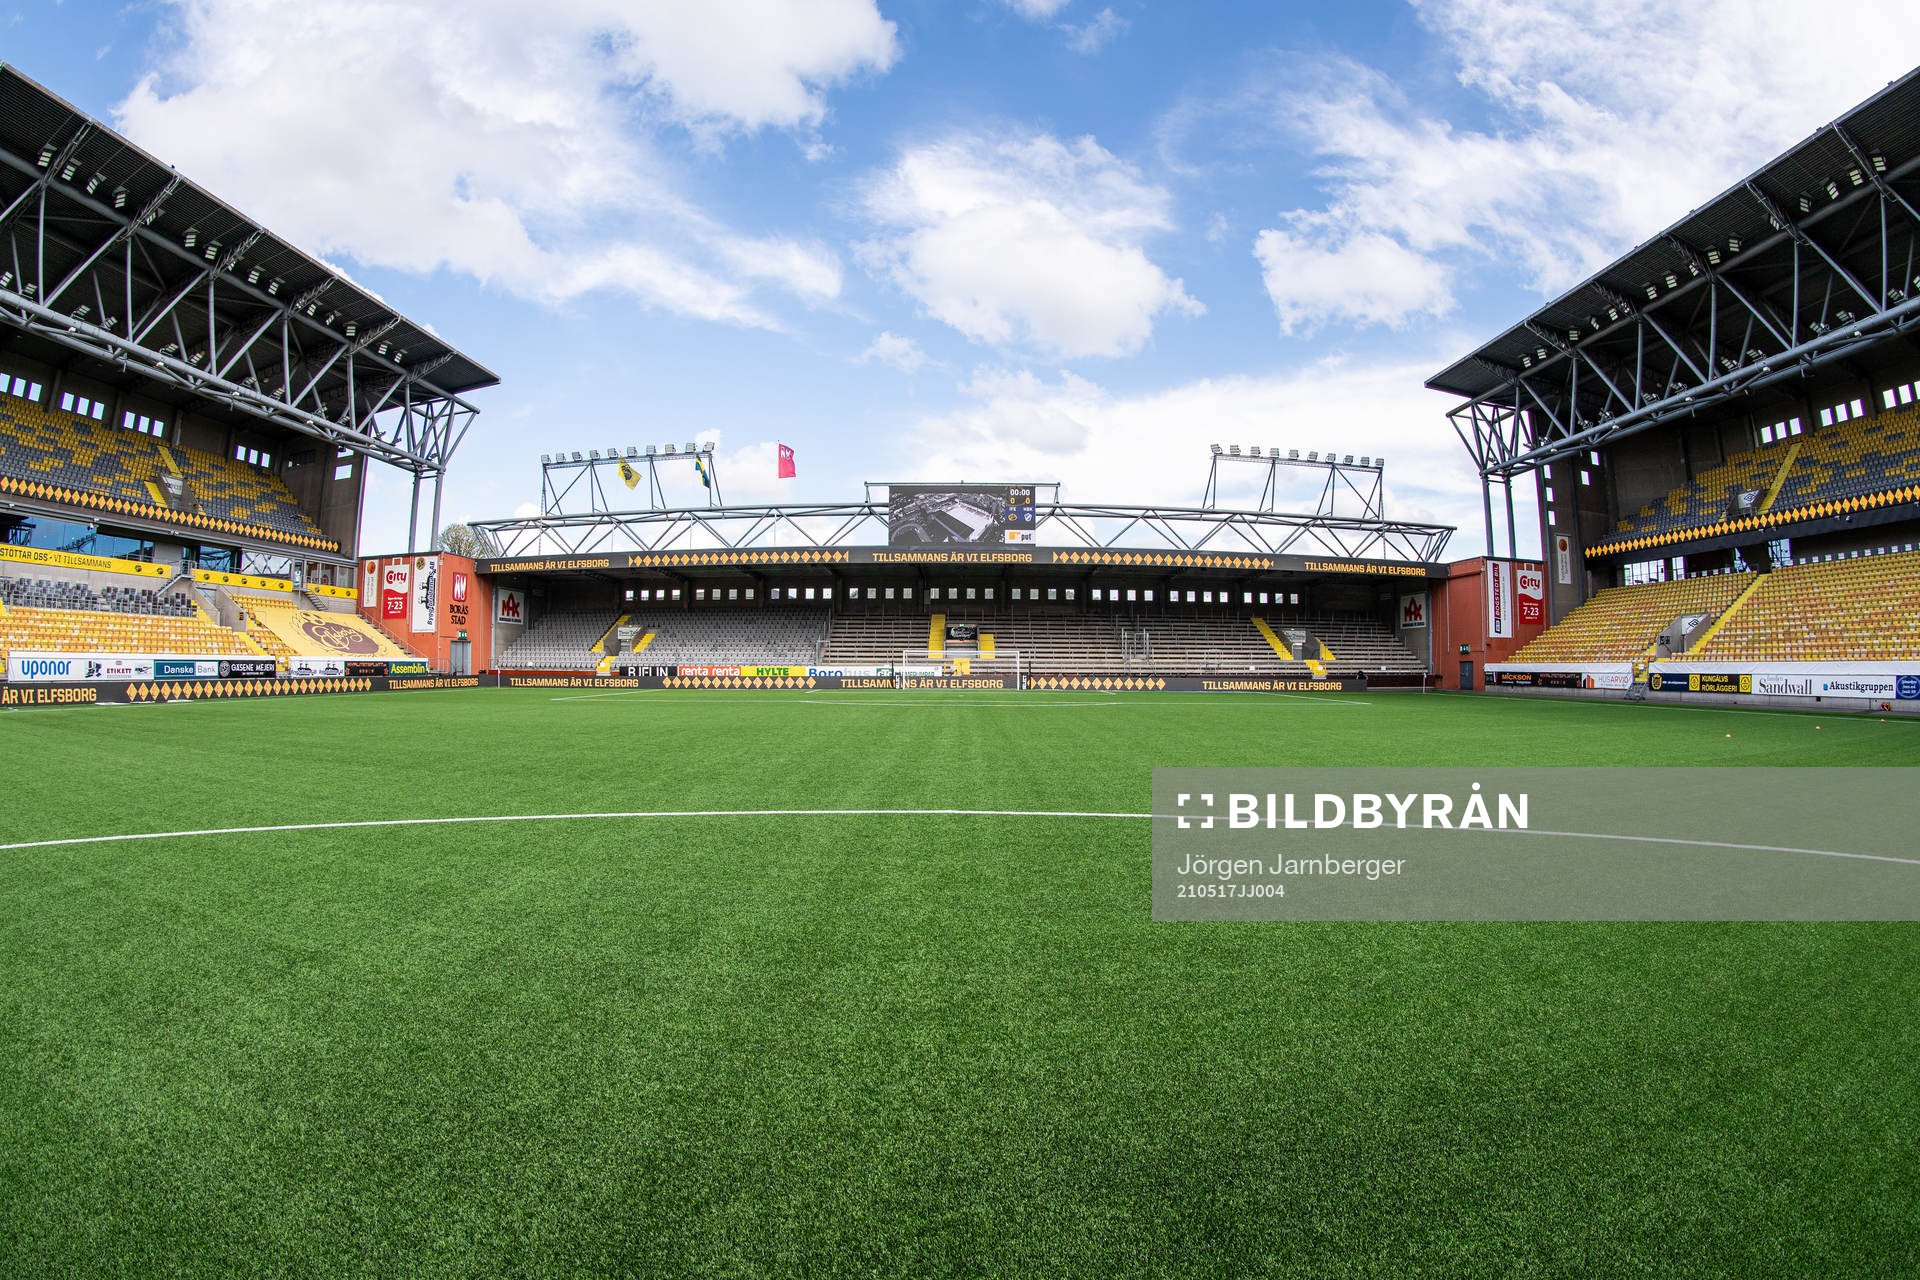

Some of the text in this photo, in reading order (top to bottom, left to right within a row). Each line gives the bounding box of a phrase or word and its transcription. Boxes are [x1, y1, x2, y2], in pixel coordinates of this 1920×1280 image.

[34, 552, 48, 561] OSS
[64, 556, 112, 568] TILLSAMMANS
[872, 552, 1032, 562] TILLSAMMANS ÄR VI ELFSBORG
[490, 559, 609, 572] TILLSAMMANS ÄR VI ELFSBORG
[1304, 562, 1426, 576] TILLSAMMANS ÄR VI ELFSBORG
[386, 570, 407, 584] City
[1520, 575, 1540, 589] City
[387, 602, 403, 610] 7-23
[450, 604, 468, 615] BORÅS
[1523, 607, 1539, 616] 7-23
[451, 615, 466, 625] STAD
[22, 660, 72, 679] uponor
[164, 665, 216, 674] Danske Bank
[256, 663, 274, 671] MEJERI
[391, 663, 425, 674] Assemblin
[681, 667, 740, 676] renta renta
[389, 678, 478, 689] TILLSAMMANS ÄR VI ELFSBORG
[510, 677, 639, 687] TILLSAMMANS ÄR VI ELFSBORG
[919, 677, 933, 688] ÄR
[936, 679, 947, 688] VI
[950, 679, 1004, 688] ELFSBORG
[1202, 680, 1342, 690] TILLSAMMANS ÄR VI ELFSBORG
[1759, 678, 1812, 695] Sandwall
[1830, 682, 1894, 693] Akustikgruppen
[2, 686, 96, 704] ÄR VI ELFSBORG
